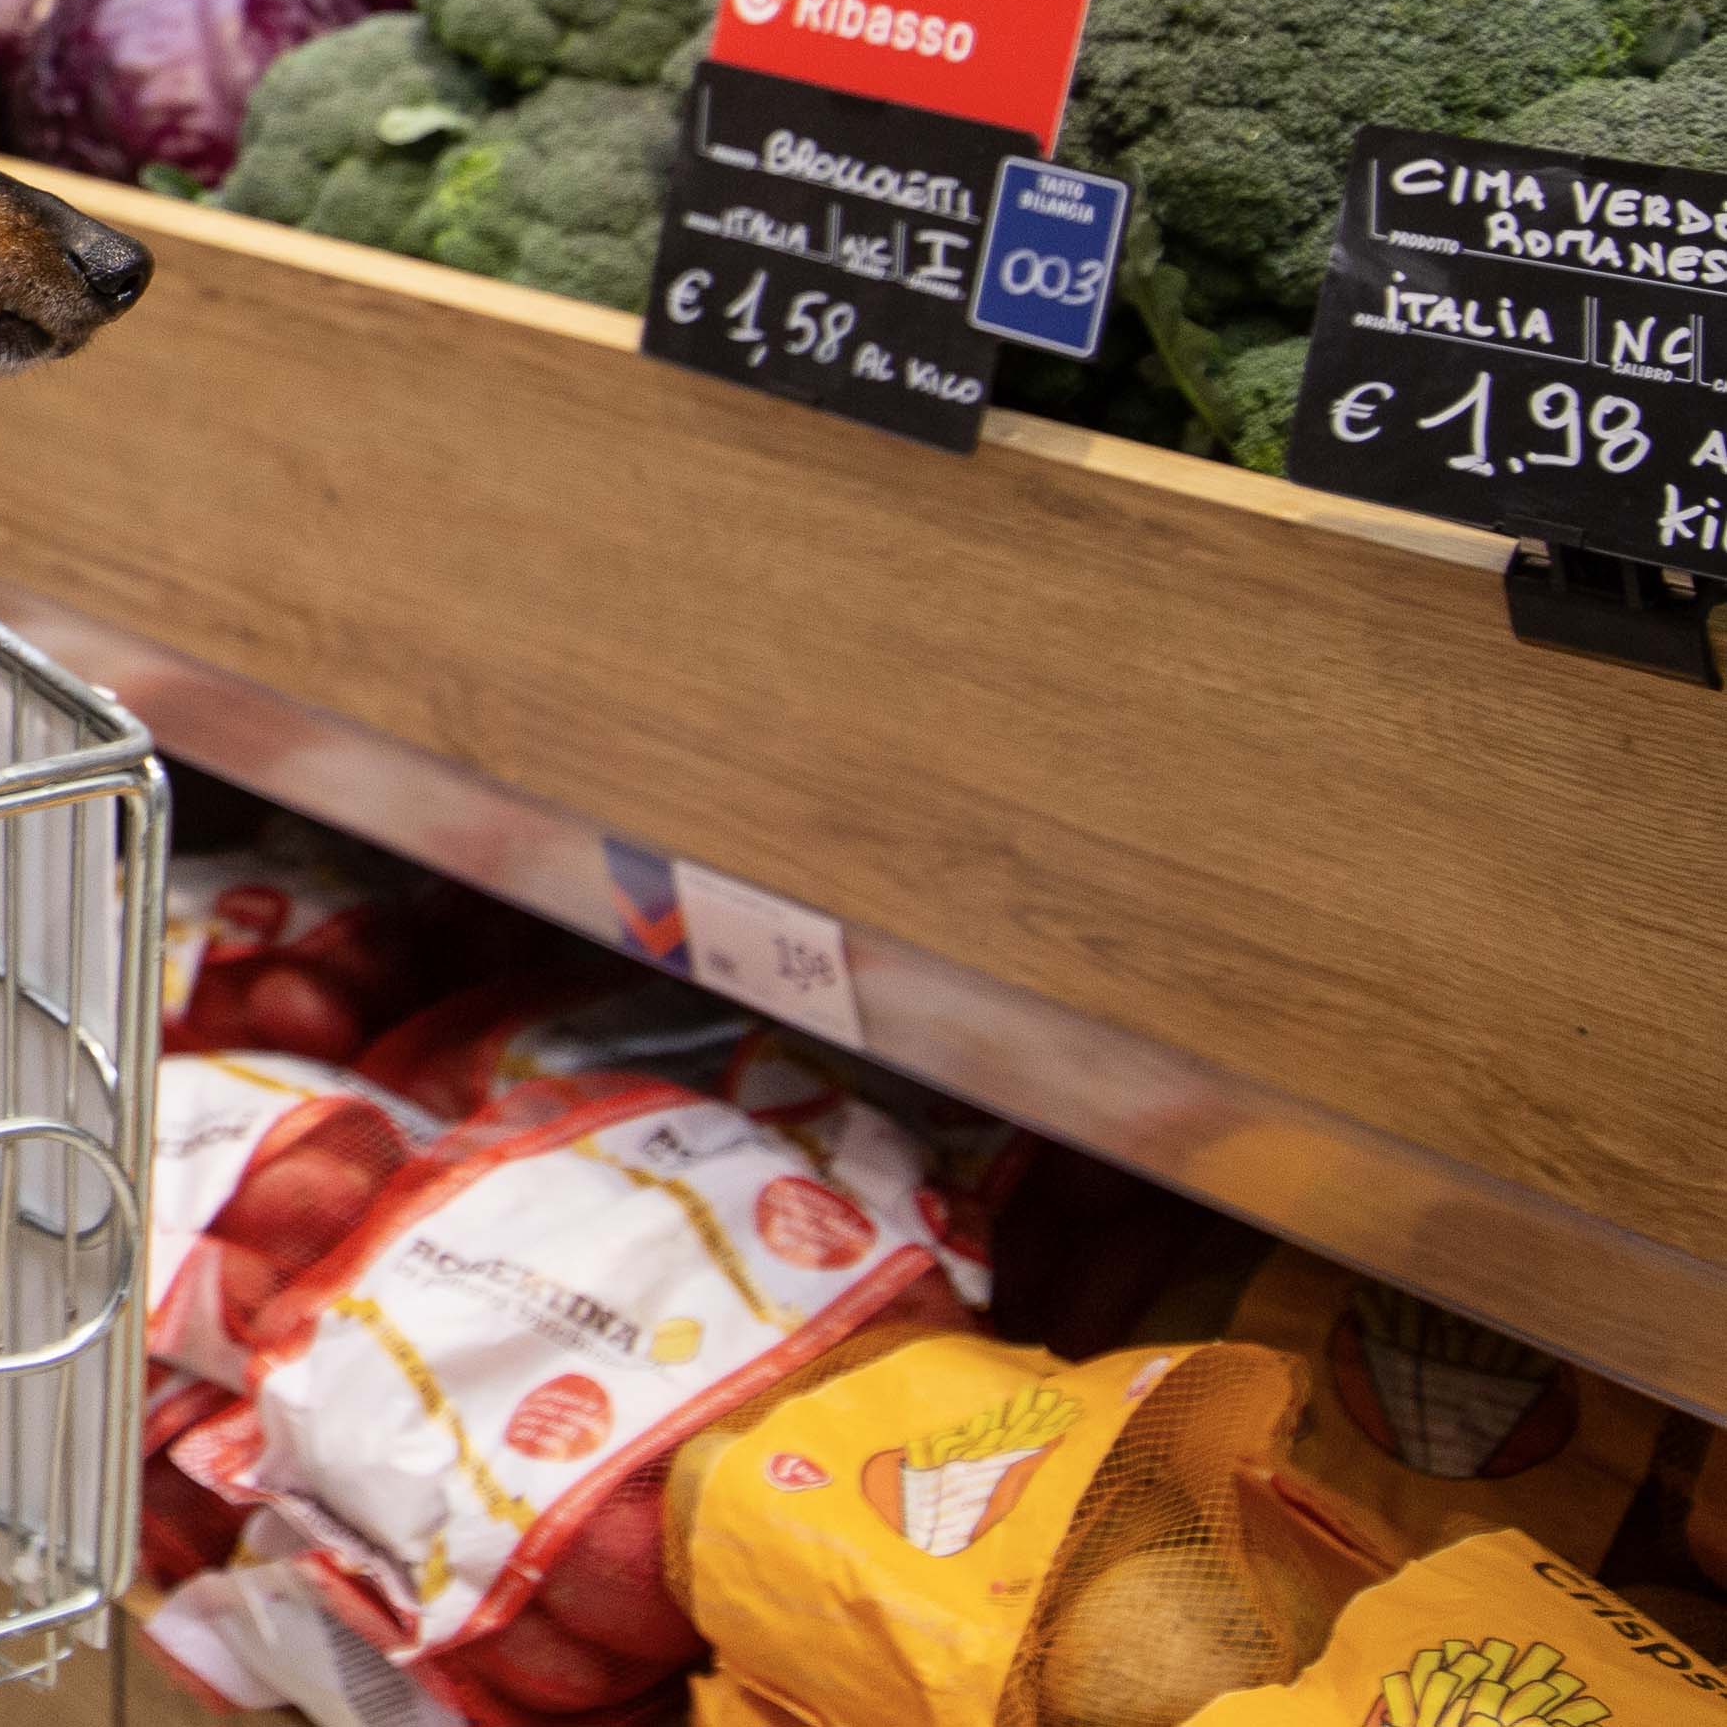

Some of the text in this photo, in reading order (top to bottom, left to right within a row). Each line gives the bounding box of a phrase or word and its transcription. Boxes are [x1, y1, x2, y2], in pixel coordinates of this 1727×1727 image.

[1390, 158, 1546, 211] CIMA
[1386, 230, 1461, 255] PRODOTTO
[665, 268, 713, 323] €
[1000, 248, 1106, 306] 003
[1609, 316, 1695, 366] NC
[1329, 381, 1395, 443] €
[1657, 481, 1727, 550] ki
[1534, 1562, 1727, 1700] Crisps
